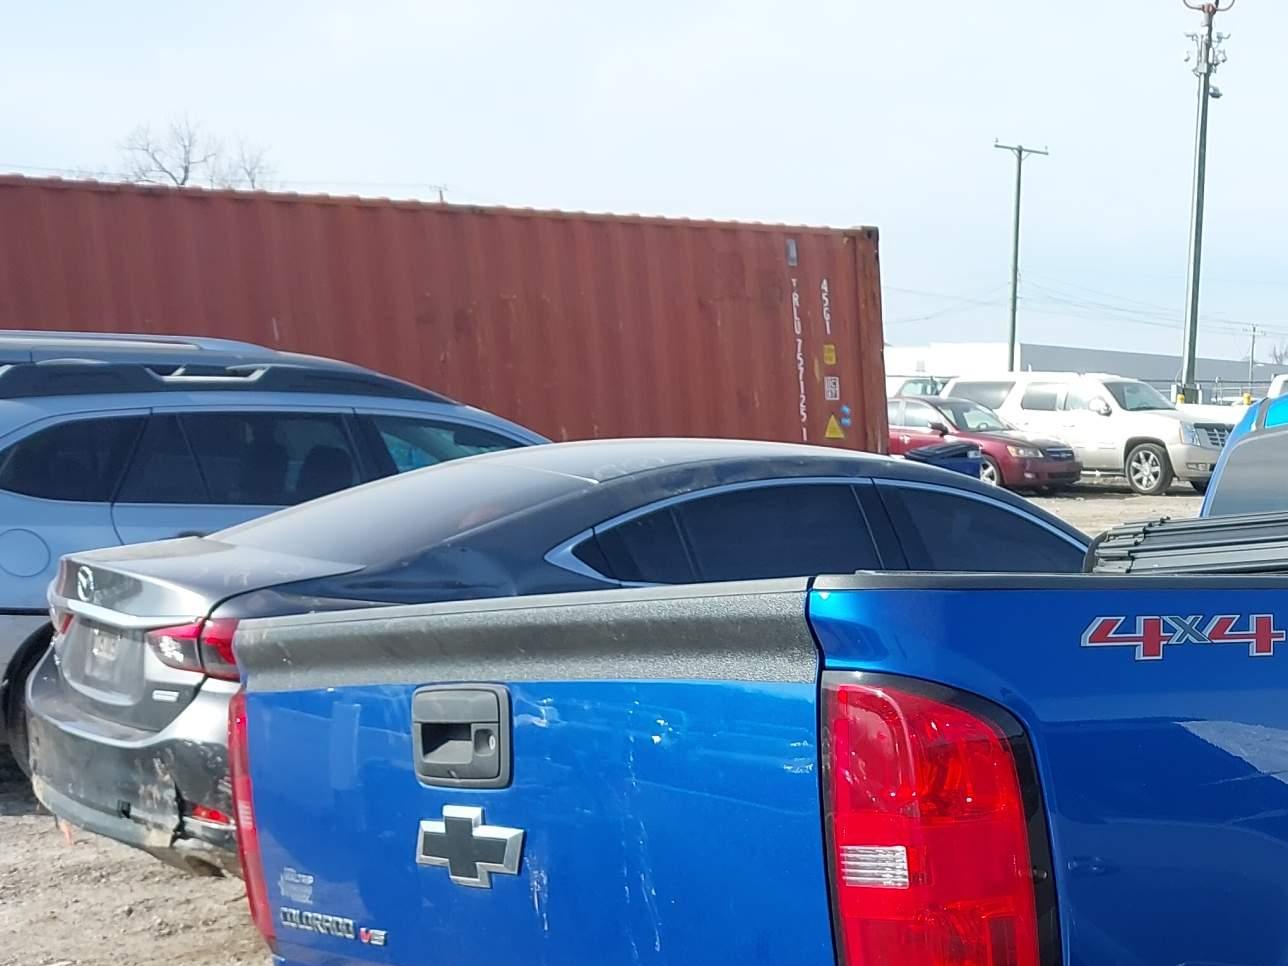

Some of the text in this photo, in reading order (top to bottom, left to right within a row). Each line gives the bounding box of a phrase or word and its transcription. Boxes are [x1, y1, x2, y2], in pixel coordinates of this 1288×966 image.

[791, 278, 802, 335] TRLU
[821, 278, 831, 335] 45G1
[280, 906, 355, 940] COLORADO
